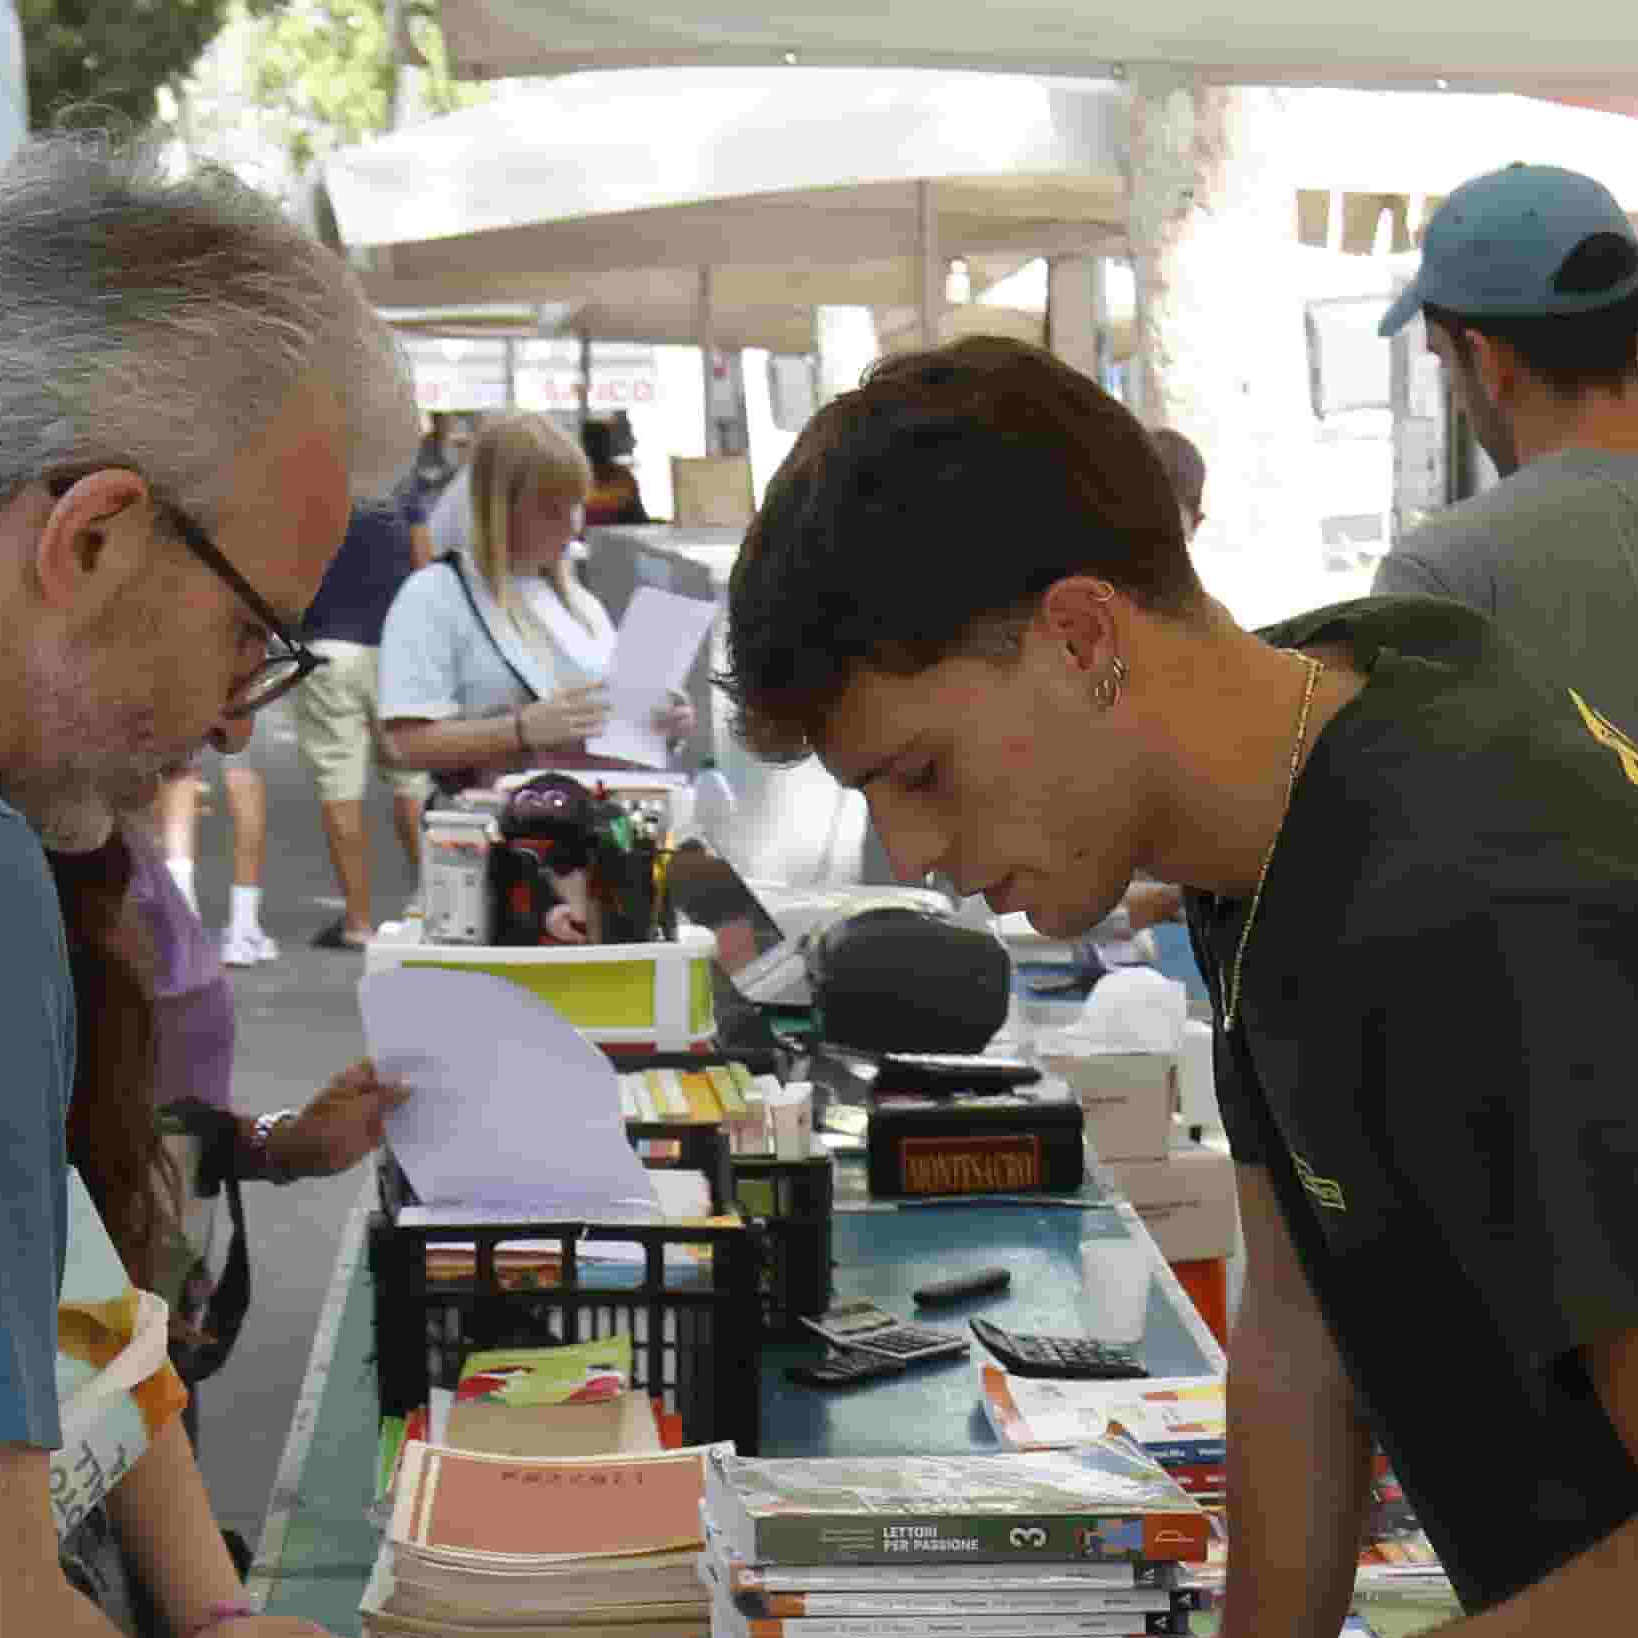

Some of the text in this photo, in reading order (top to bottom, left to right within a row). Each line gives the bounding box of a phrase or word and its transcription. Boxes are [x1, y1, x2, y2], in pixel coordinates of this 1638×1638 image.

[882, 1526, 939, 1539] LETTORI
[883, 1538, 980, 1553] PER PASSIONE
